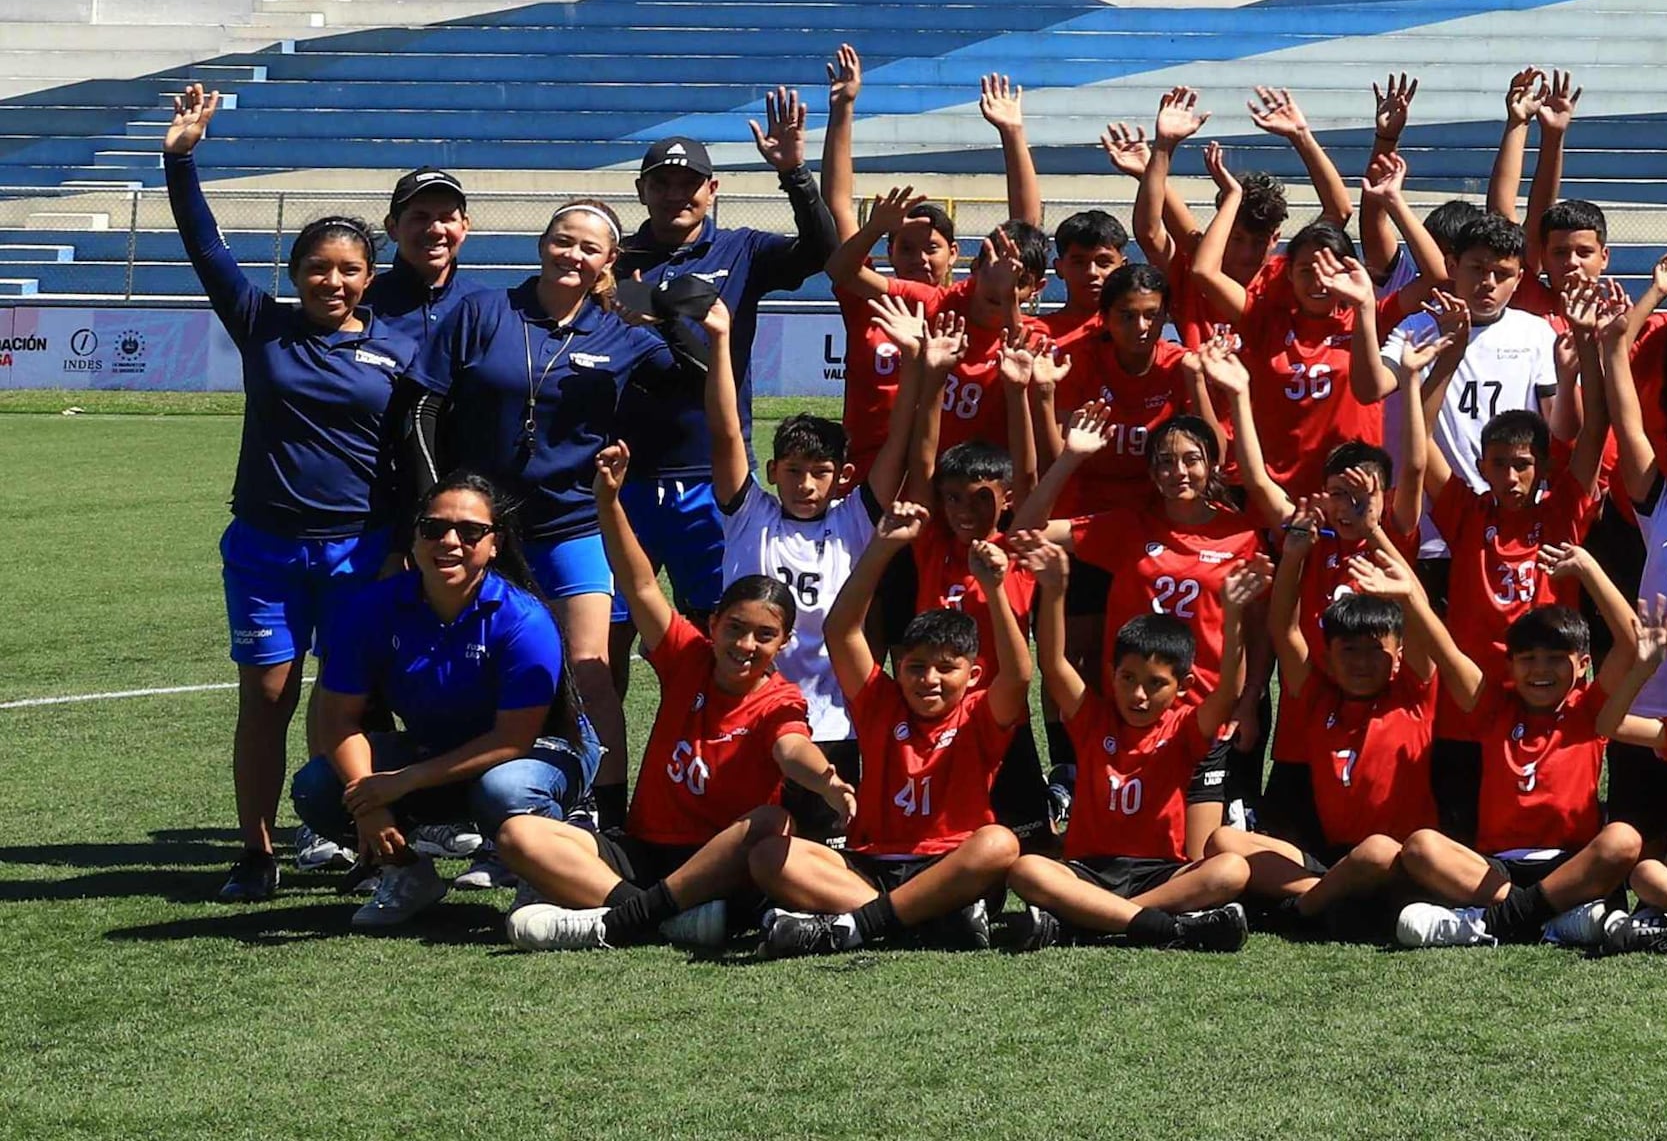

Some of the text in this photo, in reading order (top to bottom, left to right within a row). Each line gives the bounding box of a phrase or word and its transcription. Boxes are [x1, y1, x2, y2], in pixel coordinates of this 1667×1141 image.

[63, 359, 103, 370] INDES
[1285, 363, 1331, 400] 36
[1458, 381, 1503, 420] 47
[1153, 576, 1200, 618] 22
[1494, 561, 1537, 604] 39
[667, 741, 710, 795] 50
[1337, 750, 1358, 788] 7
[895, 776, 932, 817] 41
[1108, 775, 1142, 816] 10
